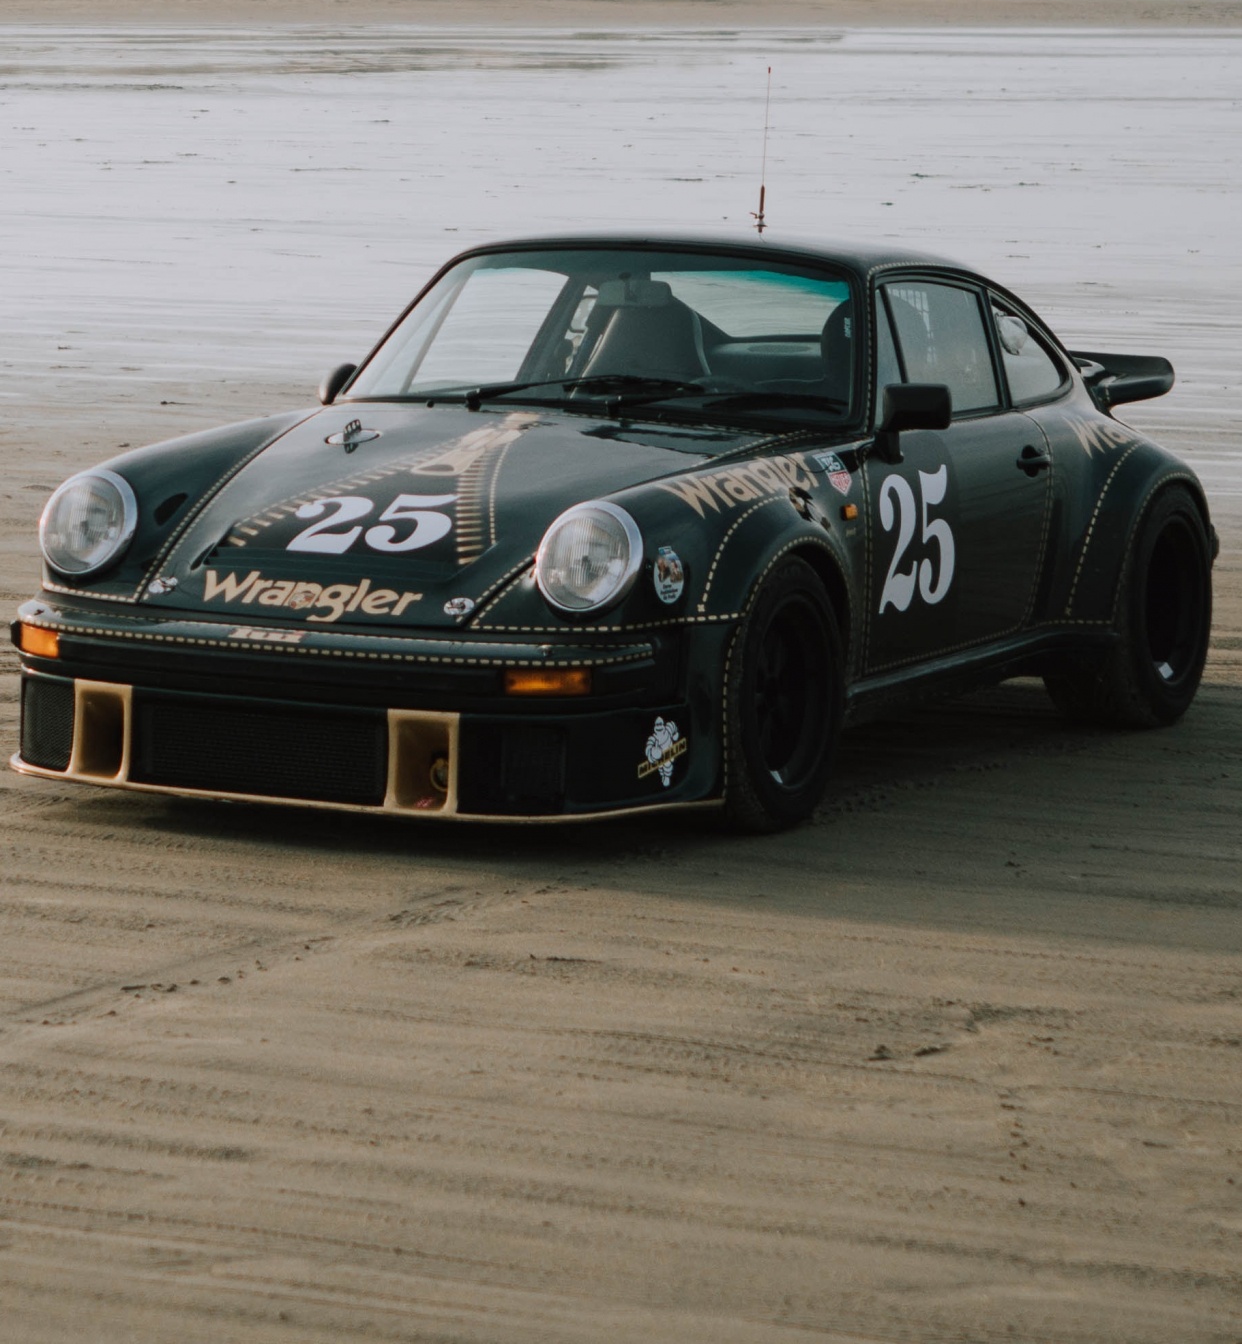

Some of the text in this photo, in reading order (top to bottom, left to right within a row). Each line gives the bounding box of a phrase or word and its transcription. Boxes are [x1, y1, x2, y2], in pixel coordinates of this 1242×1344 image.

[1061, 415, 1135, 460] Wra
[653, 452, 820, 519] Wrangler
[285, 493, 461, 554] 25
[878, 463, 956, 615] 25
[203, 569, 424, 623] Wrangler
